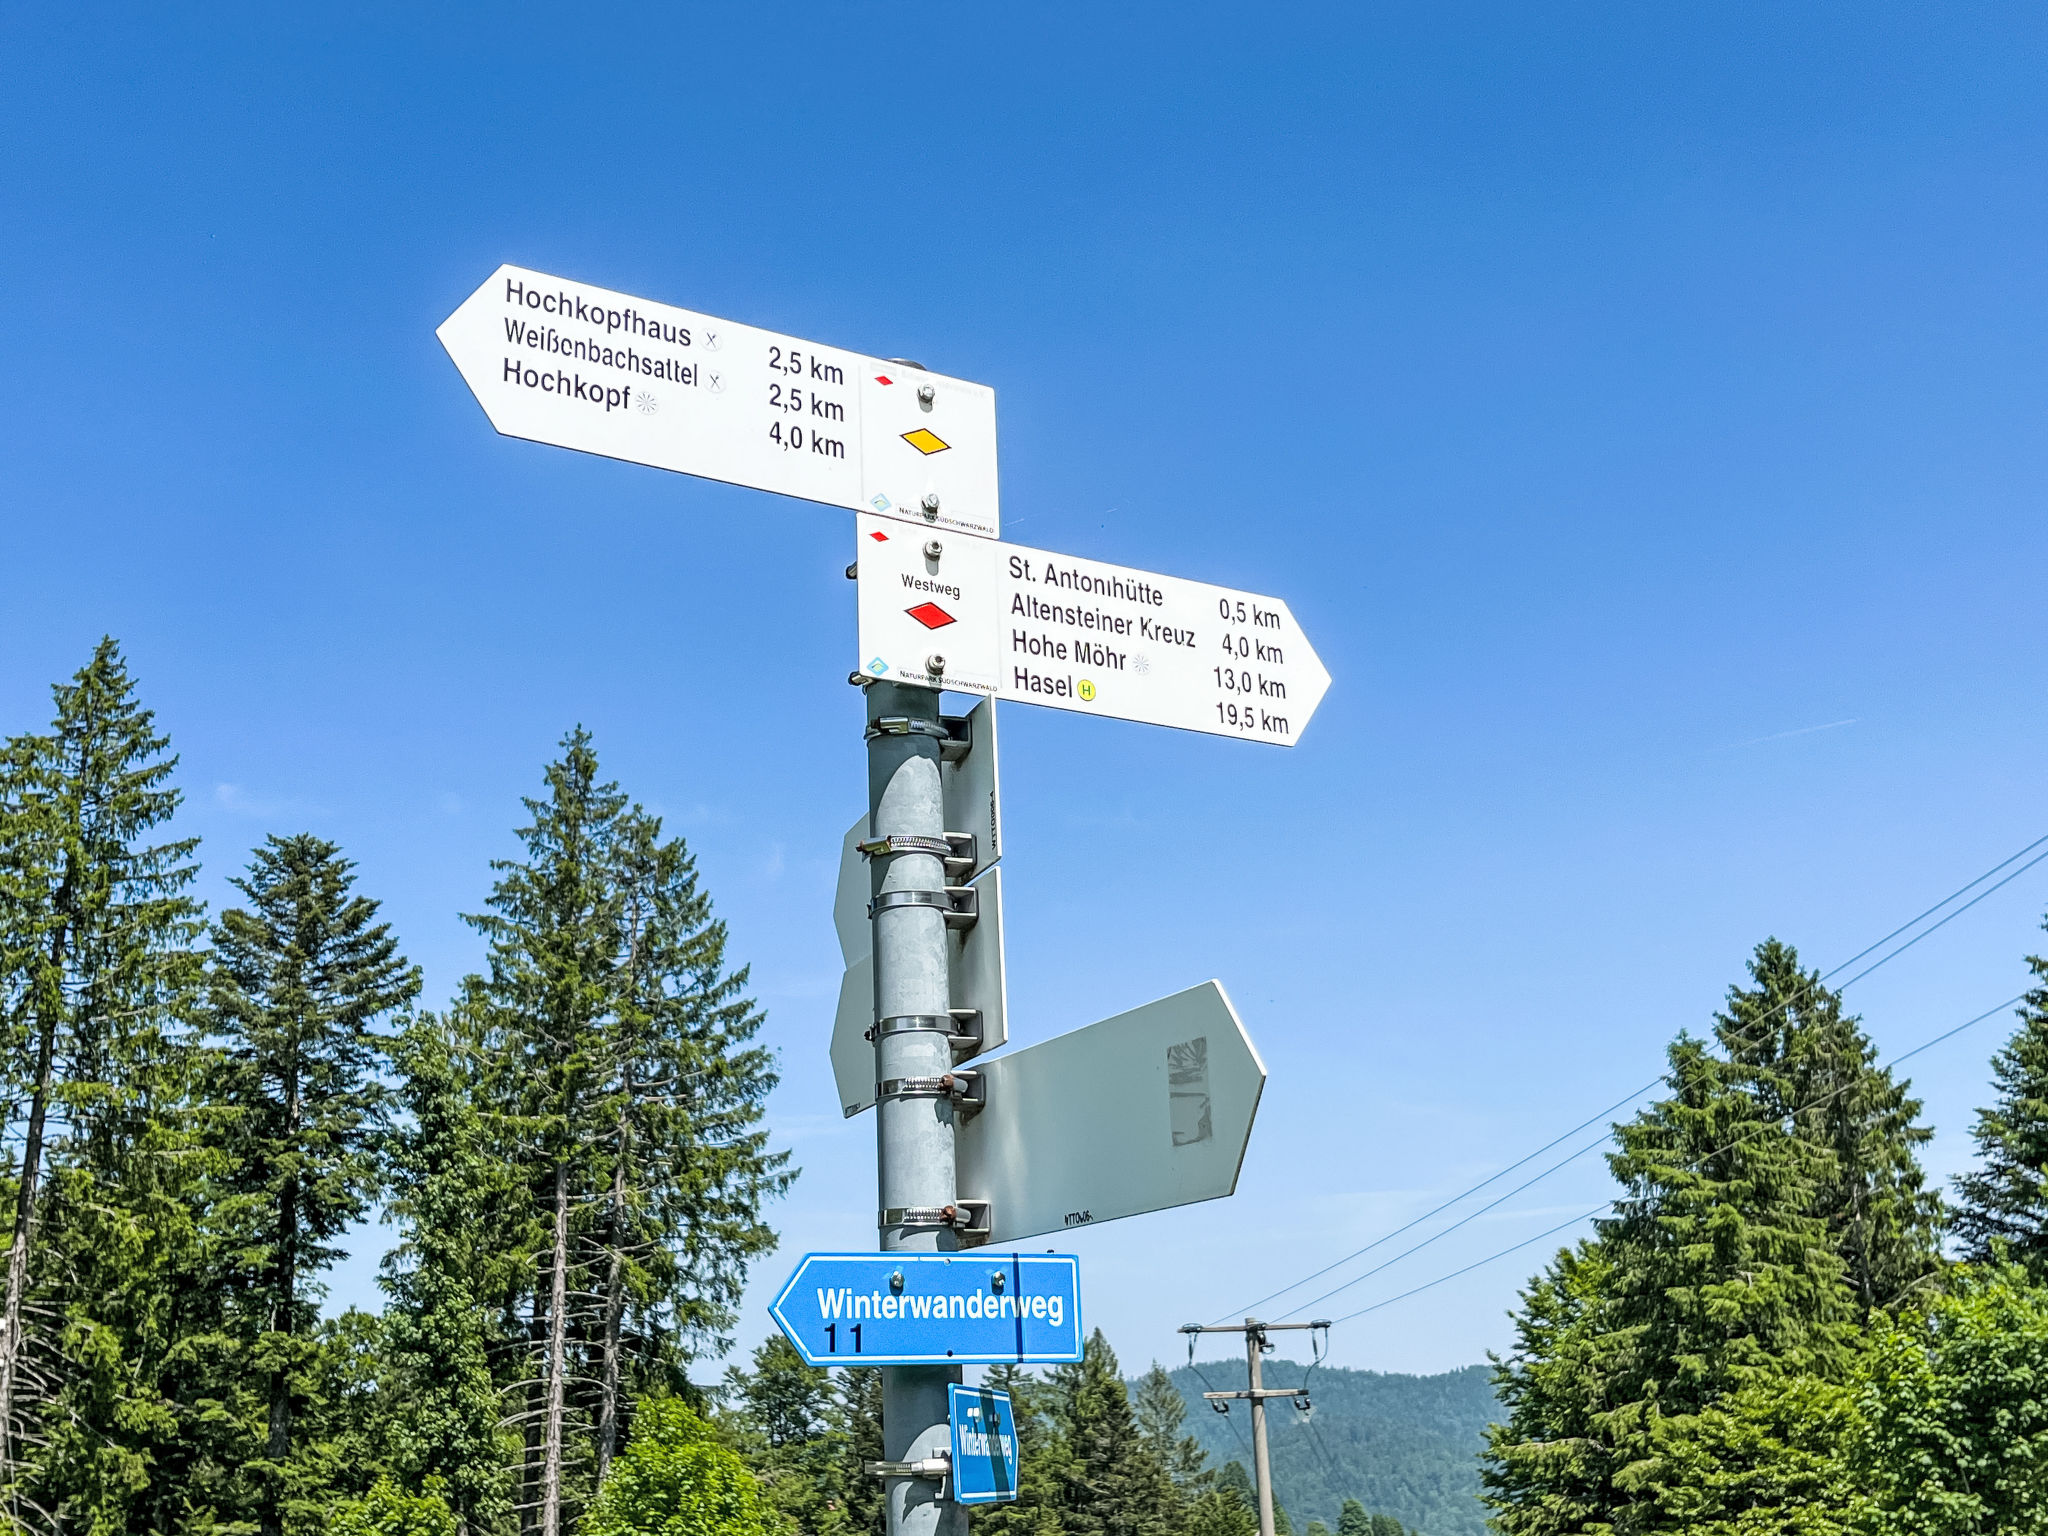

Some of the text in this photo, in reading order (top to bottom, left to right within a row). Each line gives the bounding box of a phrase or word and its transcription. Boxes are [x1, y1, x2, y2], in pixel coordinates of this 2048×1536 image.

[506, 278, 843, 385] Hochkopfhaus 2,5 km
[505, 317, 844, 422] Weißenbachsattel 2,5 km
[503, 357, 845, 459] Hochkopf 4,0 km
[901, 573, 960, 600] Westweg
[1009, 555, 1036, 582] St.
[1219, 598, 1246, 625] 0,5
[1253, 604, 1281, 629] km
[1011, 593, 1283, 664] Altensteiner Kreuz 4,0 km
[1012, 629, 1286, 699] Hohe Möhr 13,0 km
[1014, 666, 1072, 698] Hasel
[1216, 701, 1255, 731] 19,5
[1261, 708, 1289, 735] km
[816, 1287, 1063, 1327] Winterwanderweg
